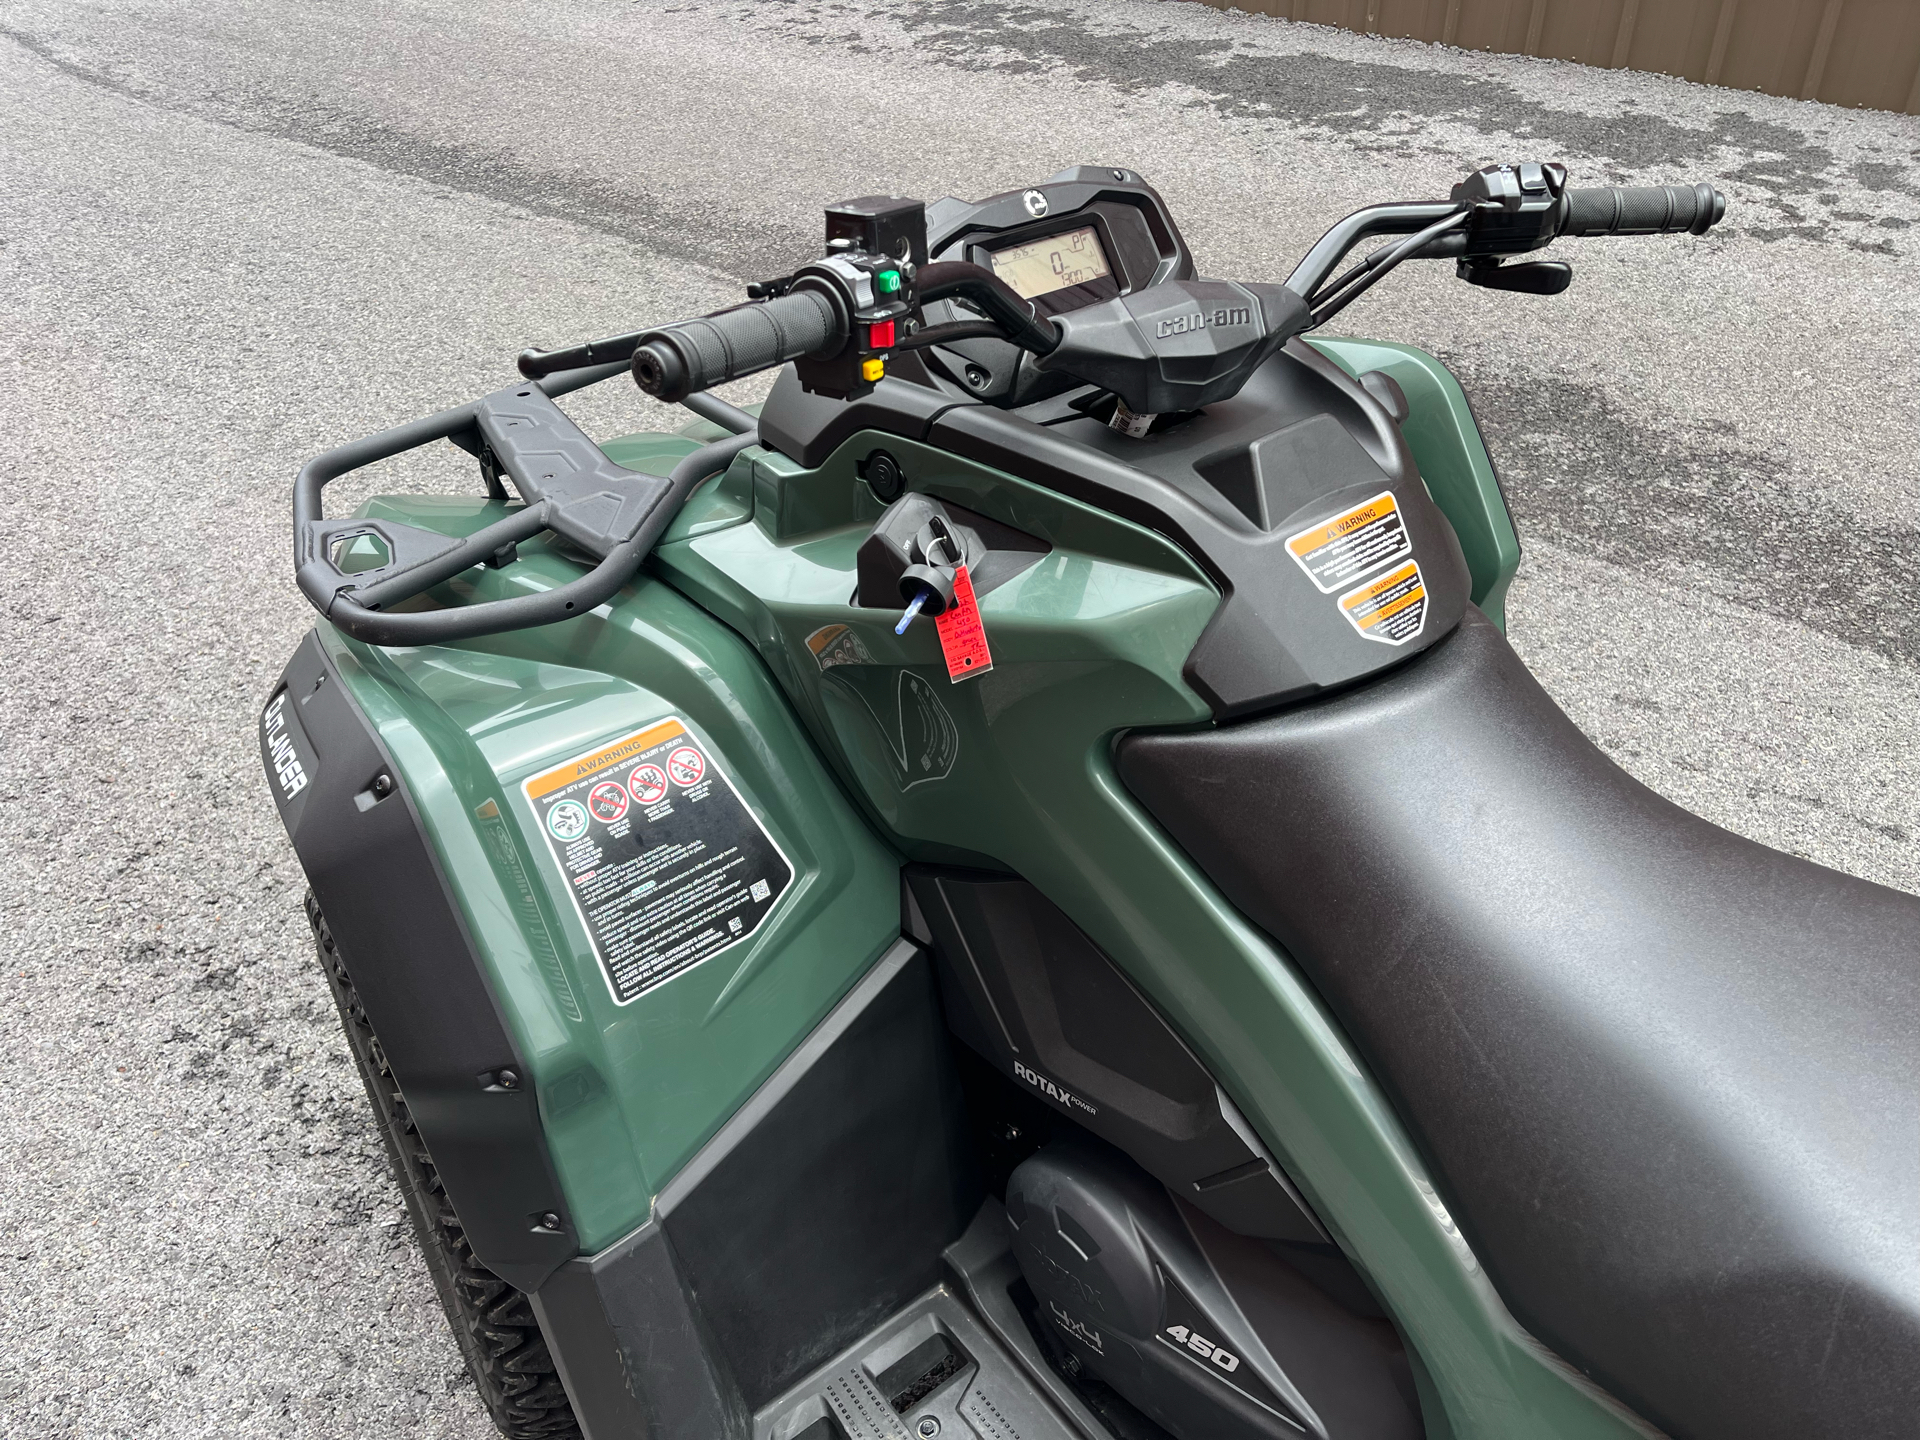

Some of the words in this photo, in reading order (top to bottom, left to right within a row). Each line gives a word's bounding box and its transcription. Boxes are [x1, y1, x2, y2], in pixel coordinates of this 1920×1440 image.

[1072, 234, 1080, 249] P
[1050, 252, 1064, 275] 0
[1062, 270, 1084, 286] 1300
[1156, 307, 1250, 339] can-am
[1335, 509, 1376, 532] WARNING
[1375, 576, 1400, 591] WARNING
[265, 694, 308, 799] OUTLANDER
[585, 740, 641, 770] WARNING
[616, 968, 638, 983] LOCATE
[637, 962, 650, 972] AND
[649, 953, 665, 965] READ
[664, 936, 698, 957] OPERATOR'S
[696, 927, 715, 940] GUIDE.
[619, 974, 643, 990] FOLLOW
[641, 968, 653, 977] ALL
[652, 947, 691, 972] INSTRUCTIONS
[694, 929, 724, 948] WARNINGS.
[1014, 1061, 1071, 1108] ROTAX
[1071, 1096, 1096, 1115] POWER
[1166, 1325, 1240, 1372] 450
